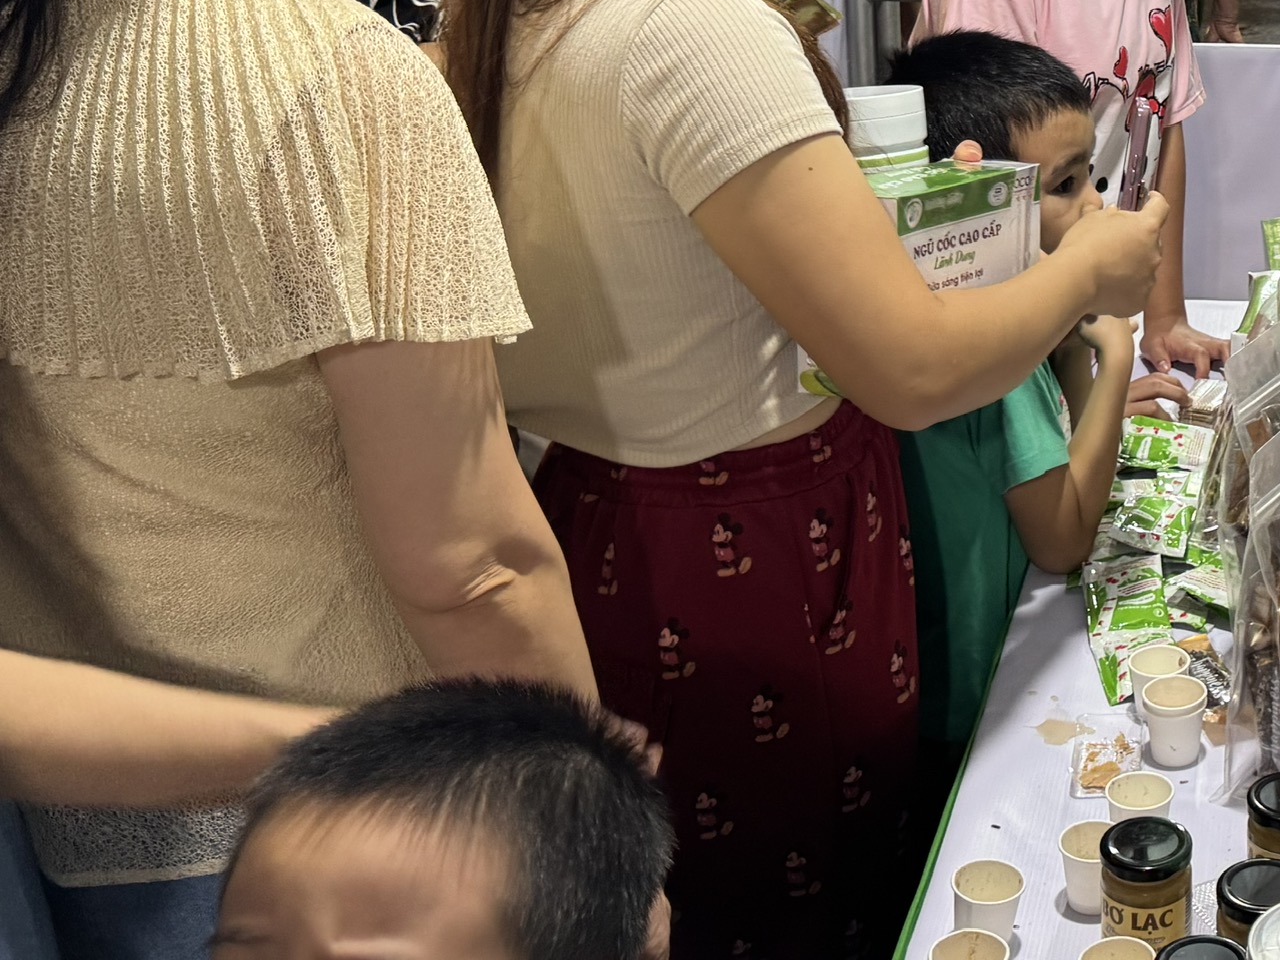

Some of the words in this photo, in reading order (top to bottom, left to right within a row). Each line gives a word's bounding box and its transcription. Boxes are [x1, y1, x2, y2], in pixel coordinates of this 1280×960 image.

[913, 238, 935, 260] NGŨ
[936, 230, 957, 253] CỐC
[959, 228, 980, 247] CAO
[982, 219, 1003, 241] CẤP
[942, 275, 959, 290] sáng
[1130, 908, 1174, 935] LẠC
